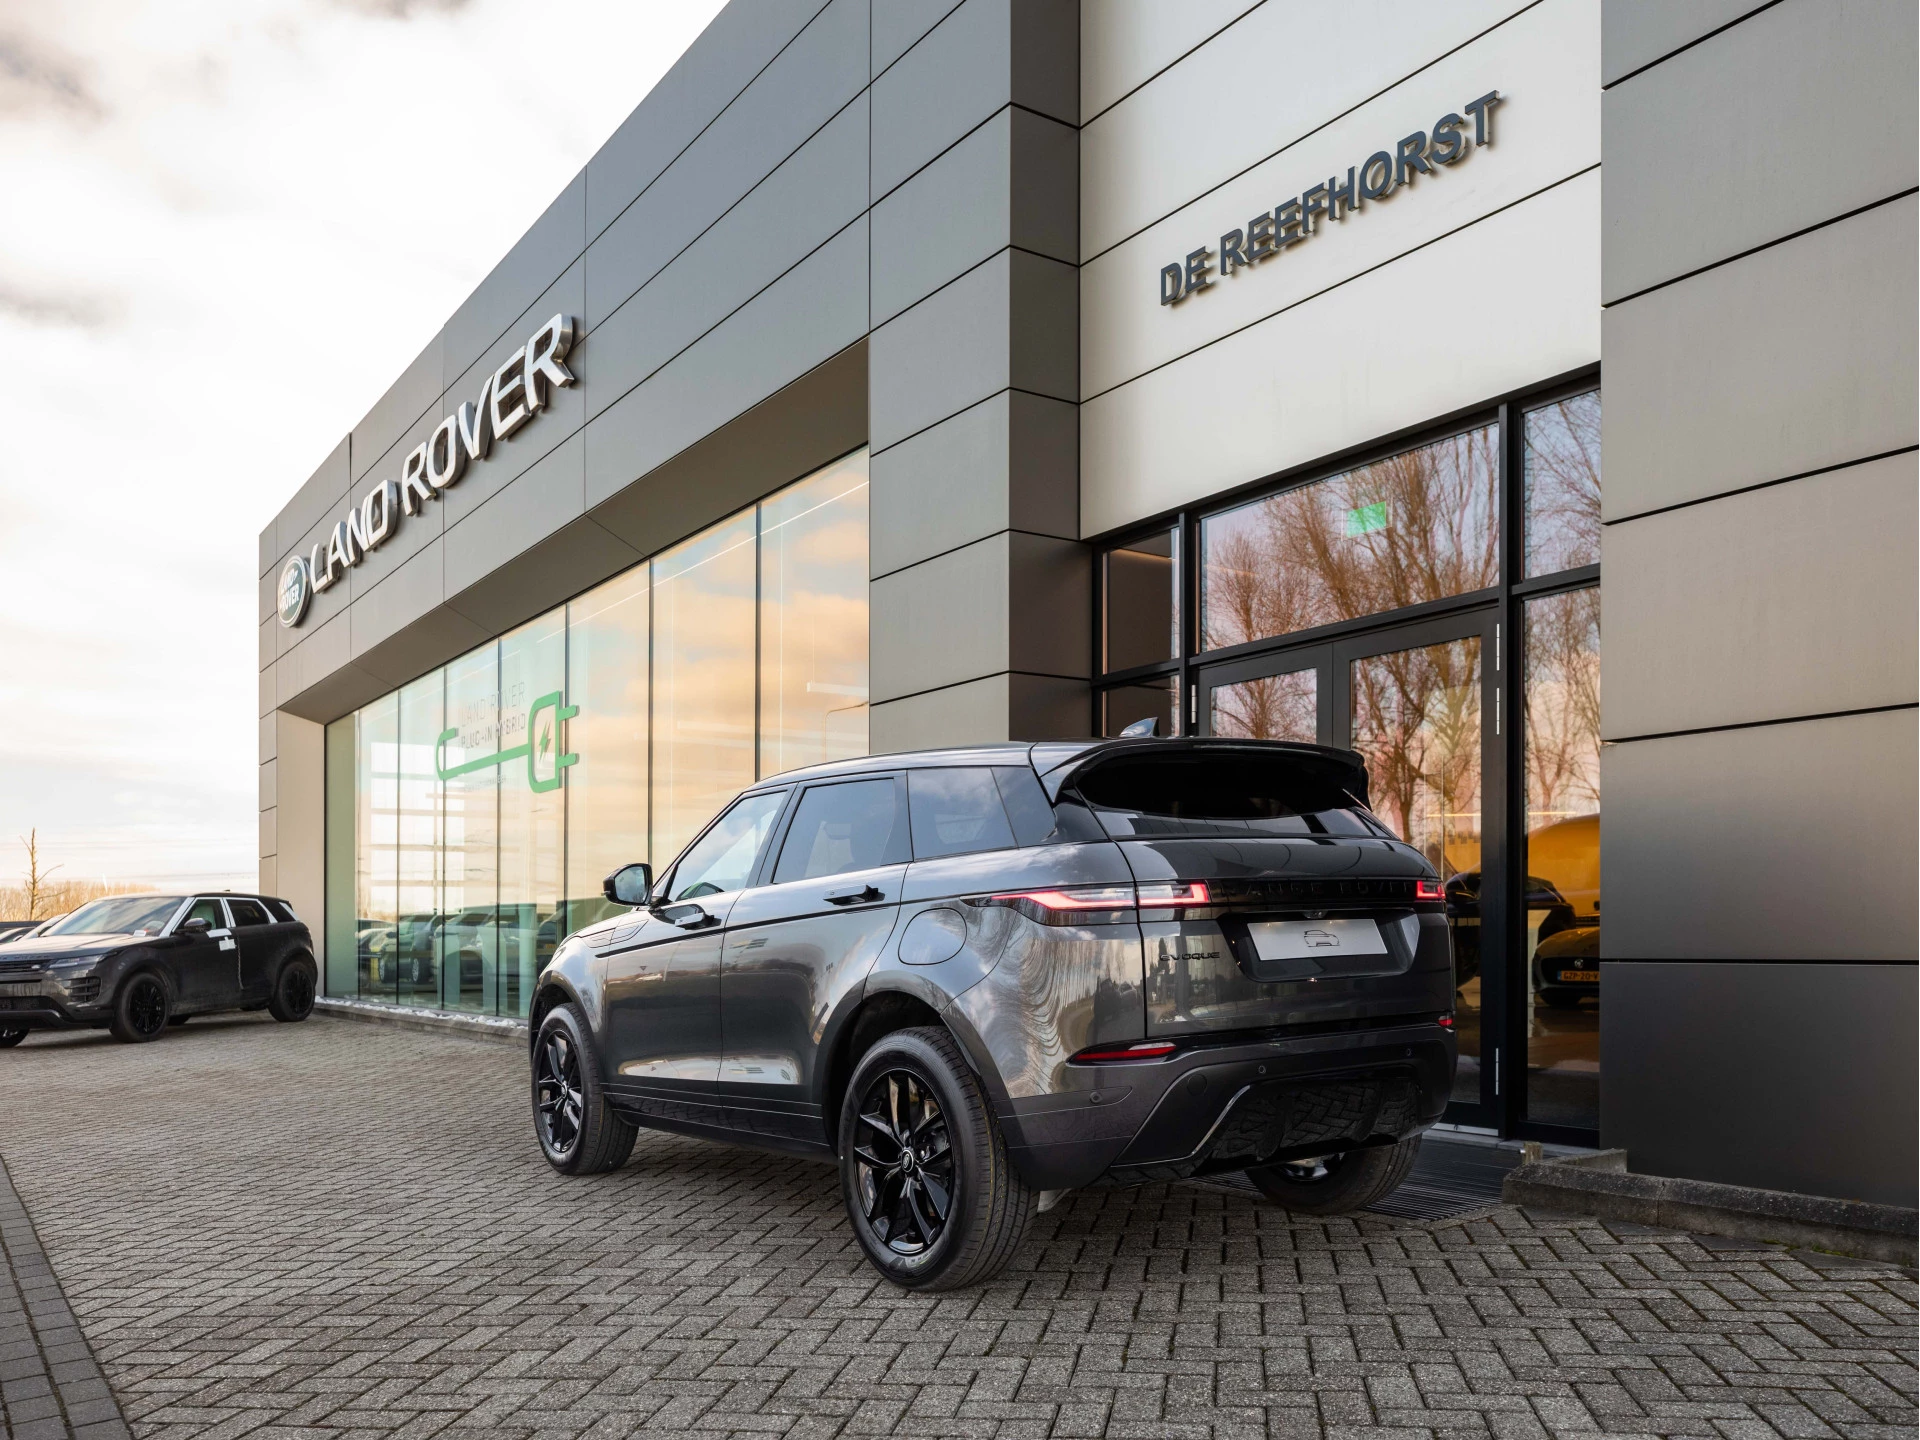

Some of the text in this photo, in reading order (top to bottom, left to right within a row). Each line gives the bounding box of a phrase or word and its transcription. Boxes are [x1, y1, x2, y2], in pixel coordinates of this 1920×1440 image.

[1160, 90, 1501, 306] DE REEFHORST
[309, 313, 575, 594] LAND ROVER
[1159, 951, 1221, 962] EVOQUE
